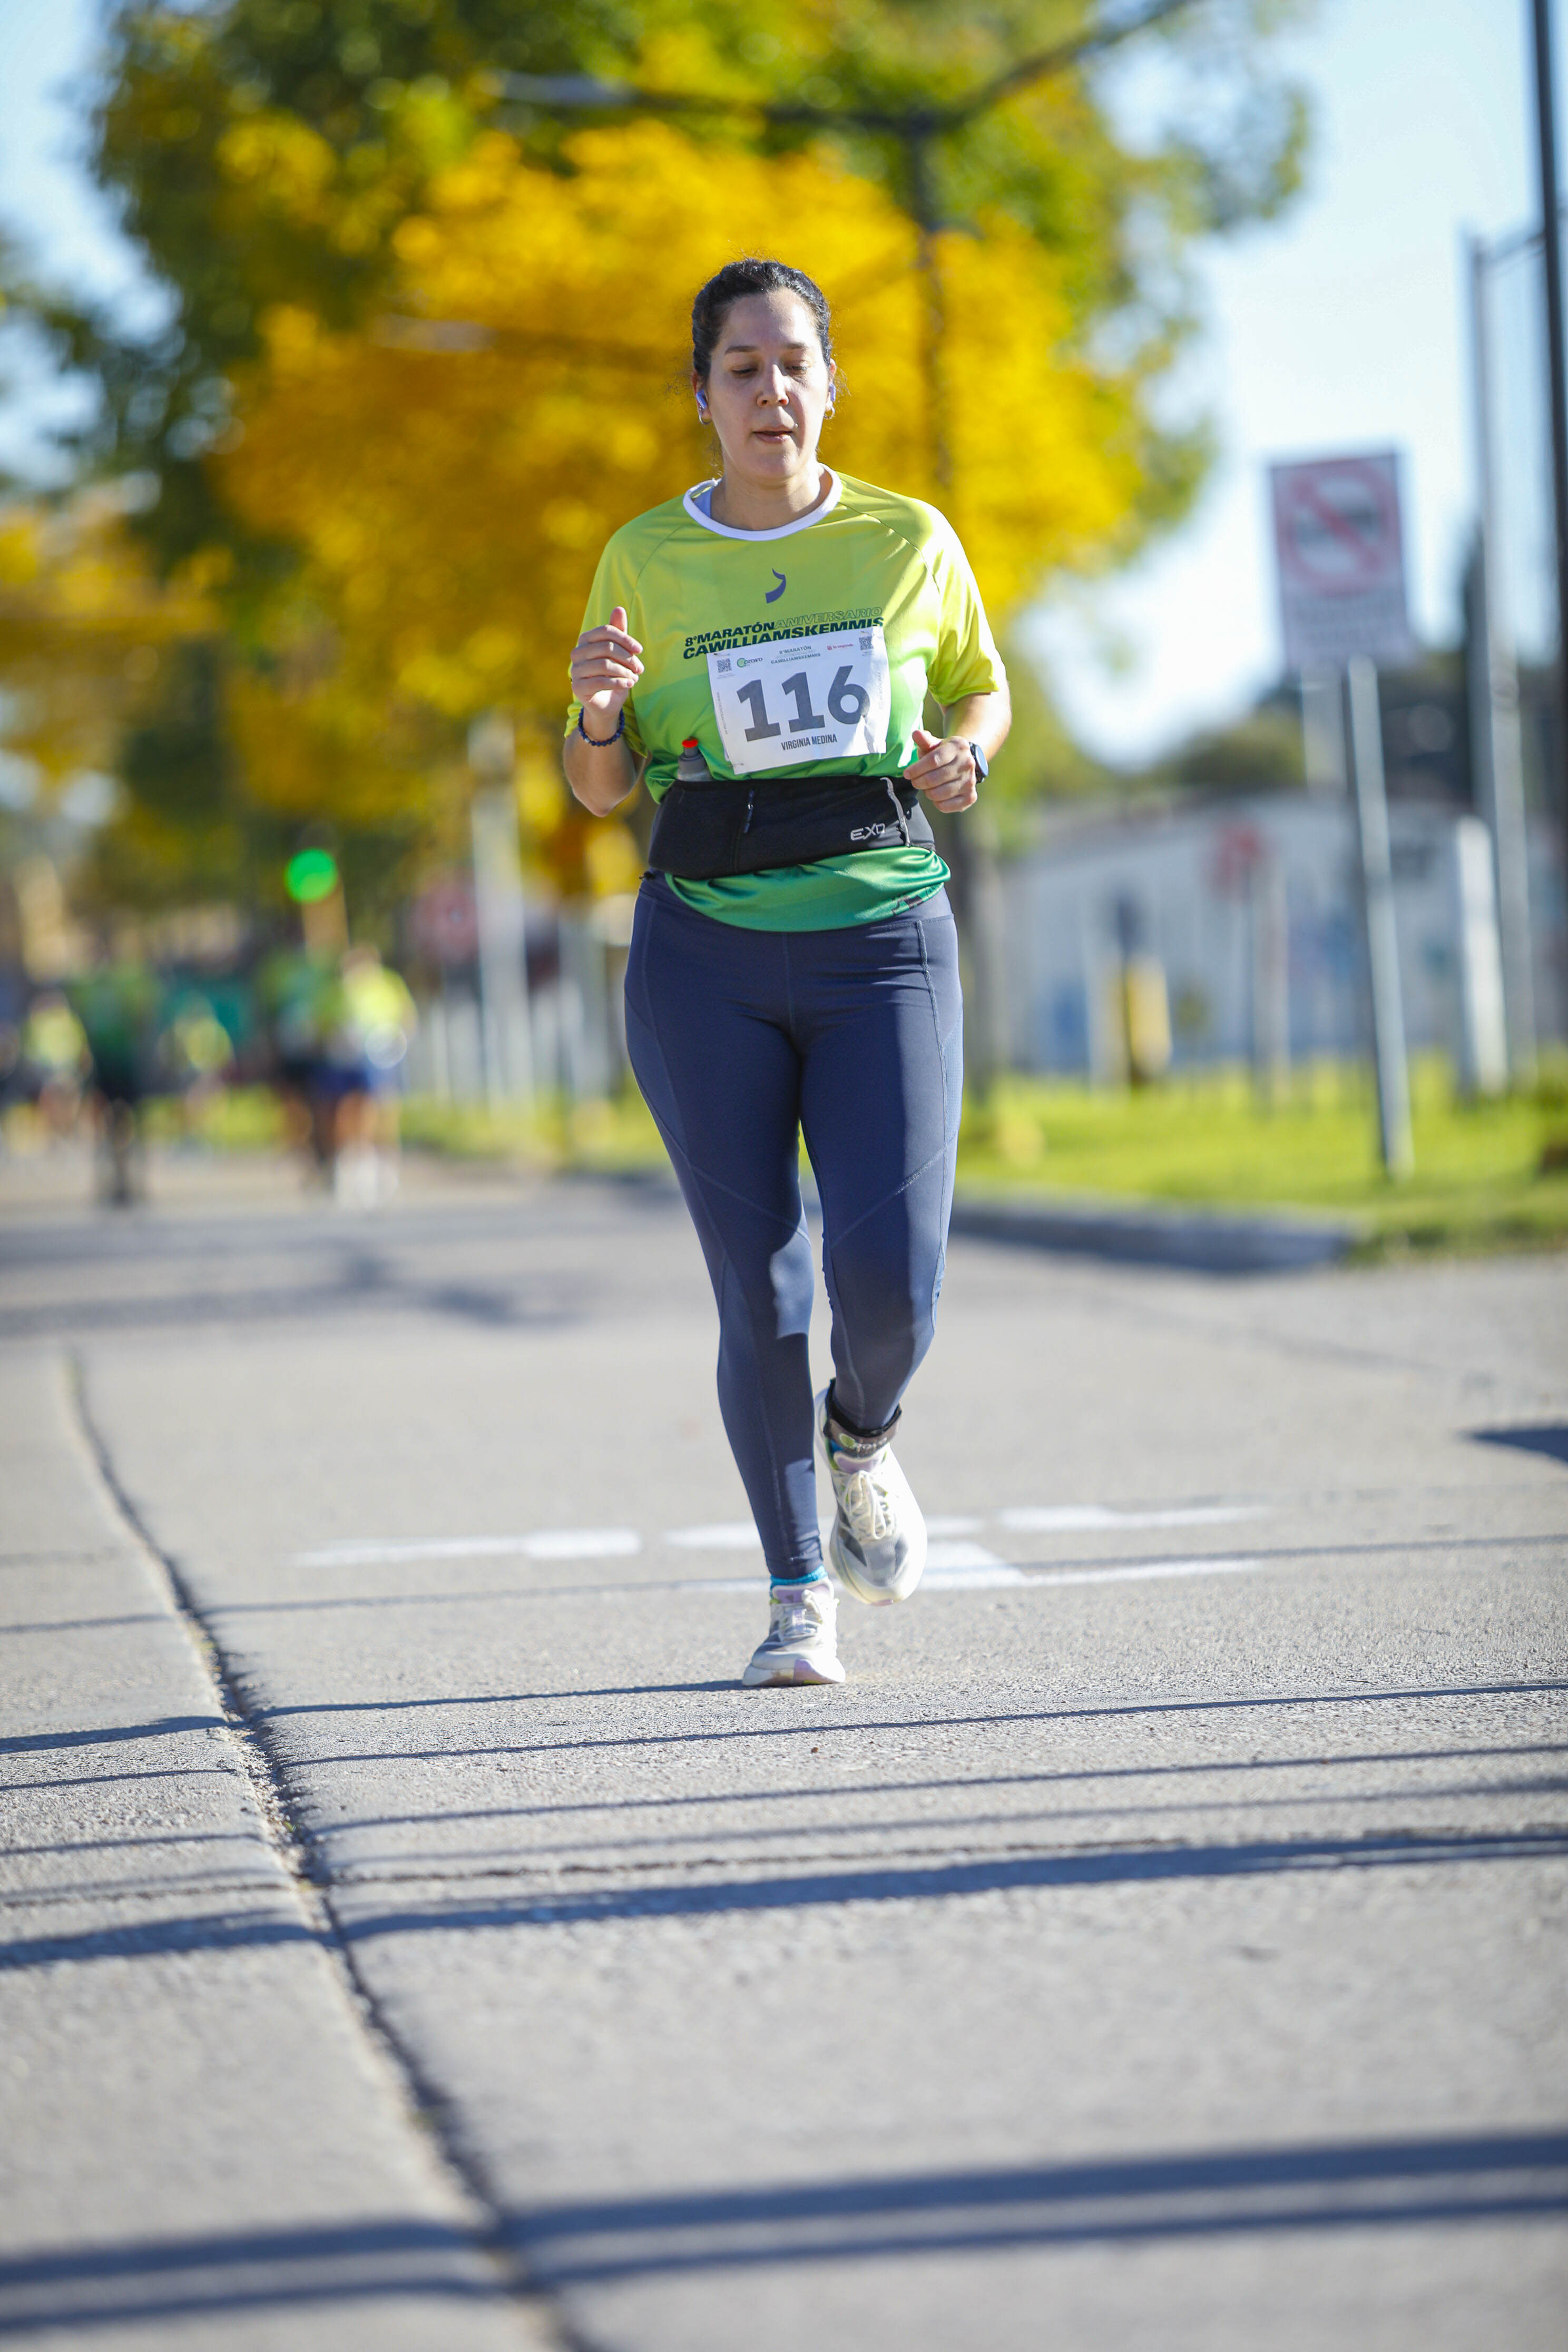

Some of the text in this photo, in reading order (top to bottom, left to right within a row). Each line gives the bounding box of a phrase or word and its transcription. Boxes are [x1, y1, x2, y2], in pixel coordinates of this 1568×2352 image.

[683, 616, 884, 659] CAWILLIAMSKEMMIS
[737, 665, 870, 742] 116
[781, 733, 838, 751] VIRGINIA MEDINA
